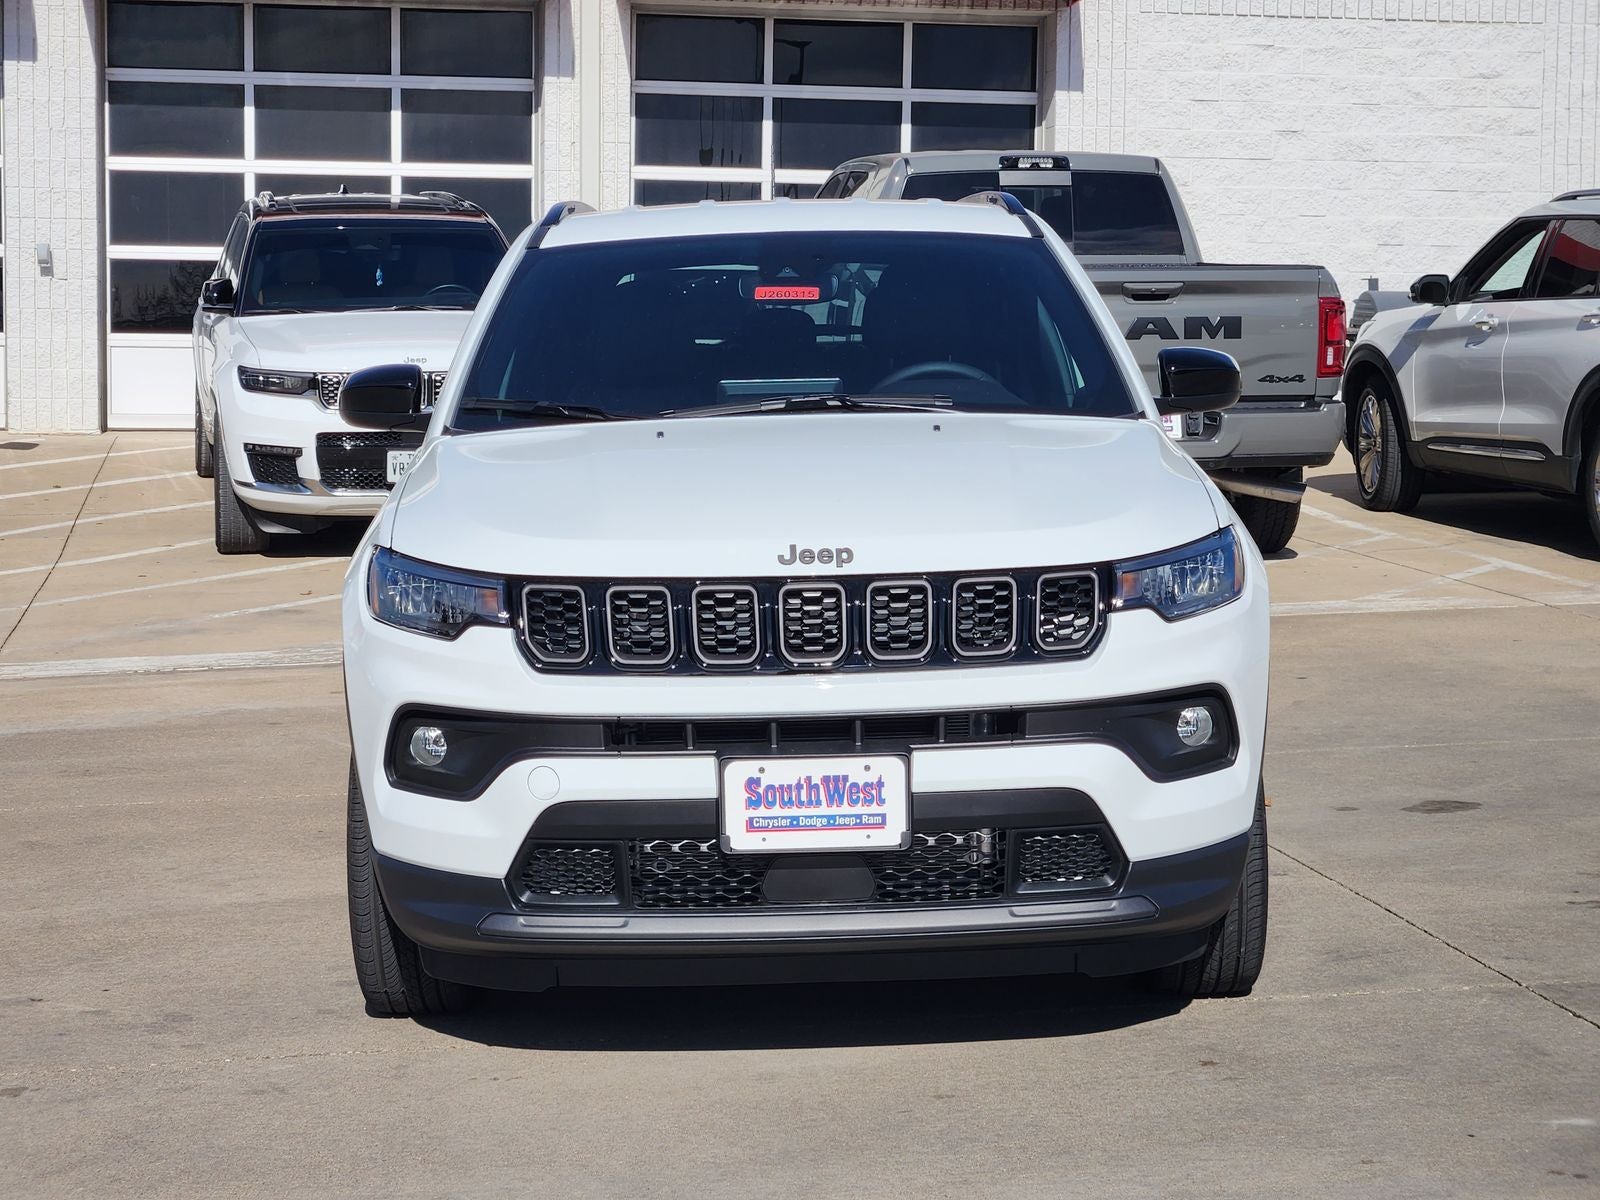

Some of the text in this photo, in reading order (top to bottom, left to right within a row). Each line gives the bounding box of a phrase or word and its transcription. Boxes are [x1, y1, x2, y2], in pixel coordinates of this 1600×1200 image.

[760, 290, 816, 299] J260315
[1125, 315, 1243, 341] AM
[403, 356, 428, 364] Jeep
[1256, 373, 1307, 384] 4x4
[777, 543, 854, 568] Jeep
[744, 774, 886, 810] SouthWest
[753, 814, 882, 828] Chrysler Dodge Jeep Ram
